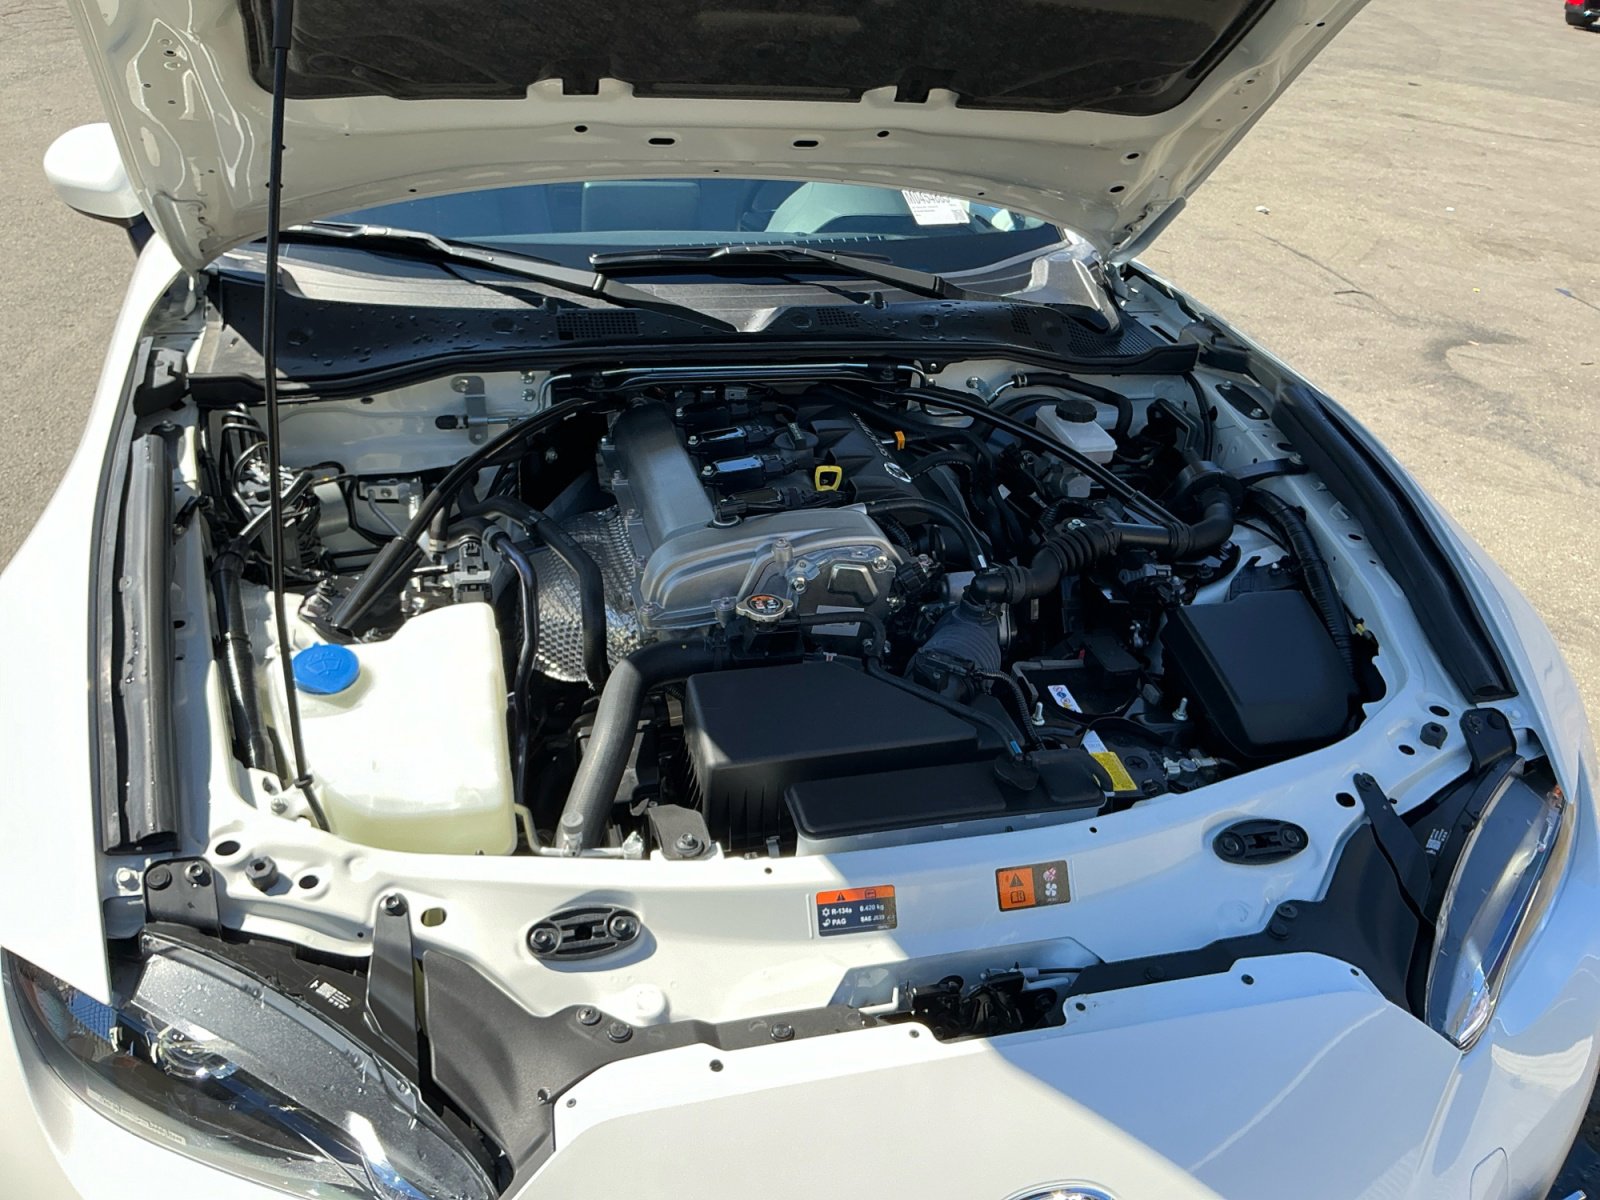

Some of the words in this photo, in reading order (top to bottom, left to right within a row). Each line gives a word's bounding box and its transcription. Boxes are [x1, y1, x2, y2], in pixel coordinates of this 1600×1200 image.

[831, 907, 853, 916] R-134a
[832, 918, 847, 926] PAG
[860, 915, 872, 923] SAE
